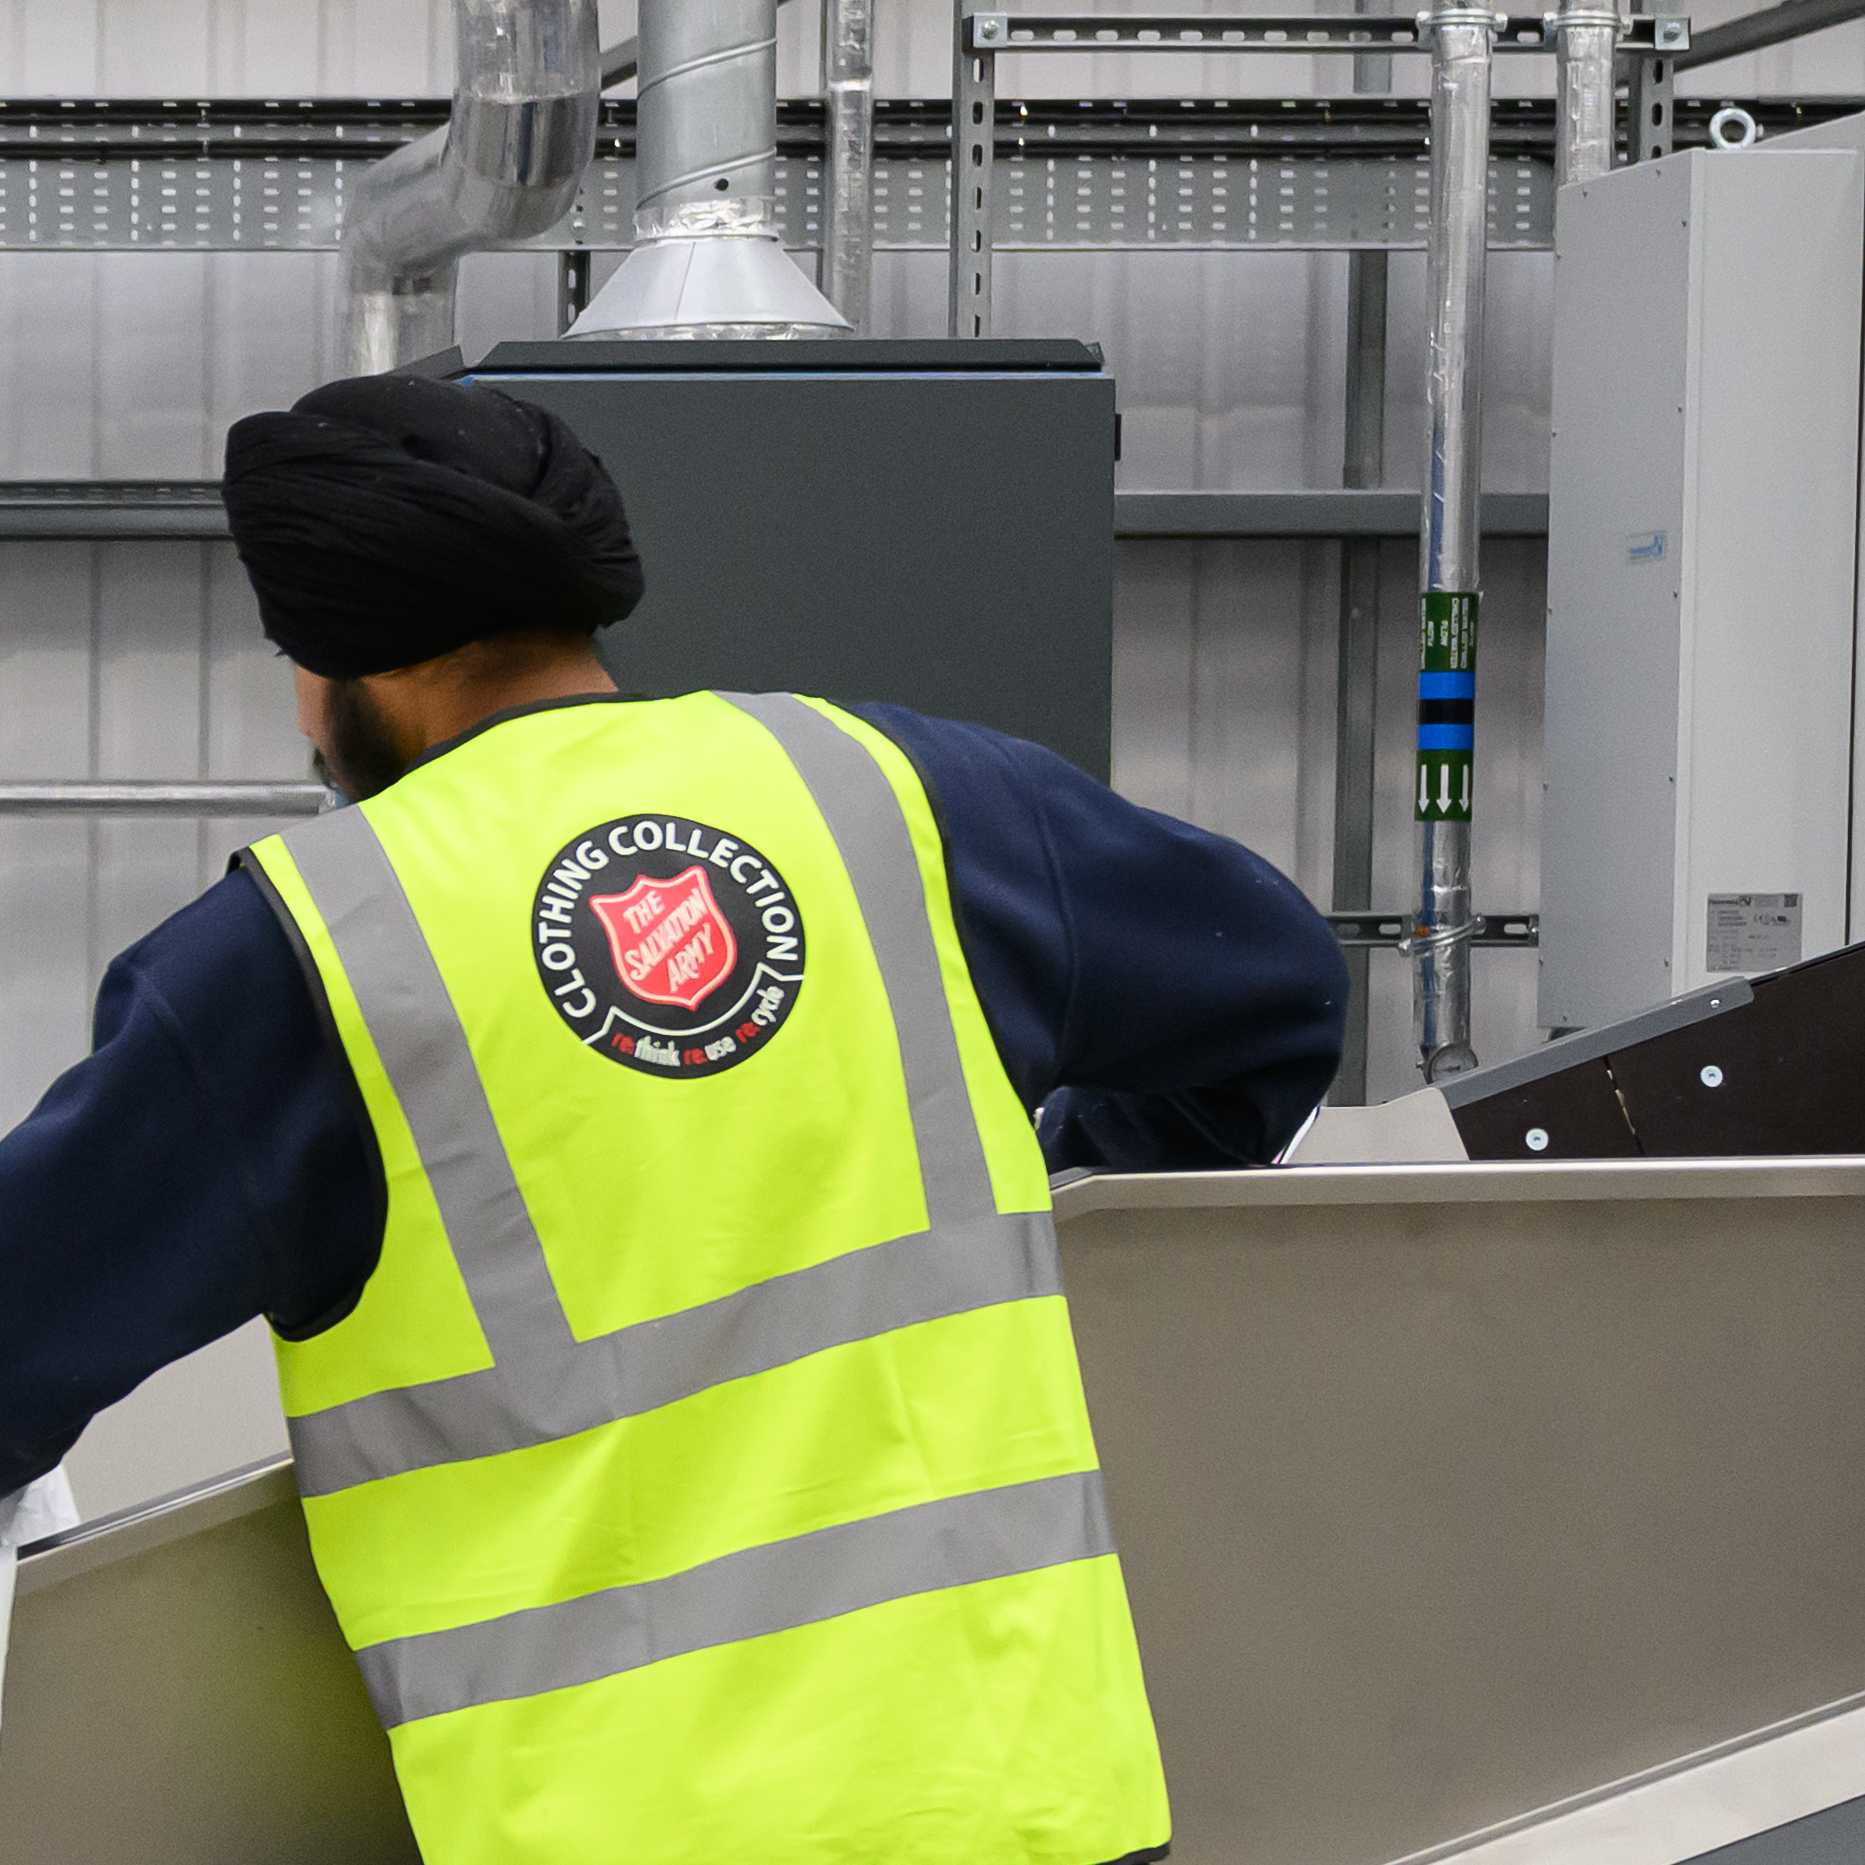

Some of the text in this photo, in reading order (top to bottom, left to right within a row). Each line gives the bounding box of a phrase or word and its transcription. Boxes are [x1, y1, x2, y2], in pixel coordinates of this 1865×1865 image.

[538, 820, 799, 1018] CLOTHING COLLECTION
[622, 889, 666, 934] THE
[624, 888, 709, 982] SALVATION
[667, 922, 715, 993] ARMY
